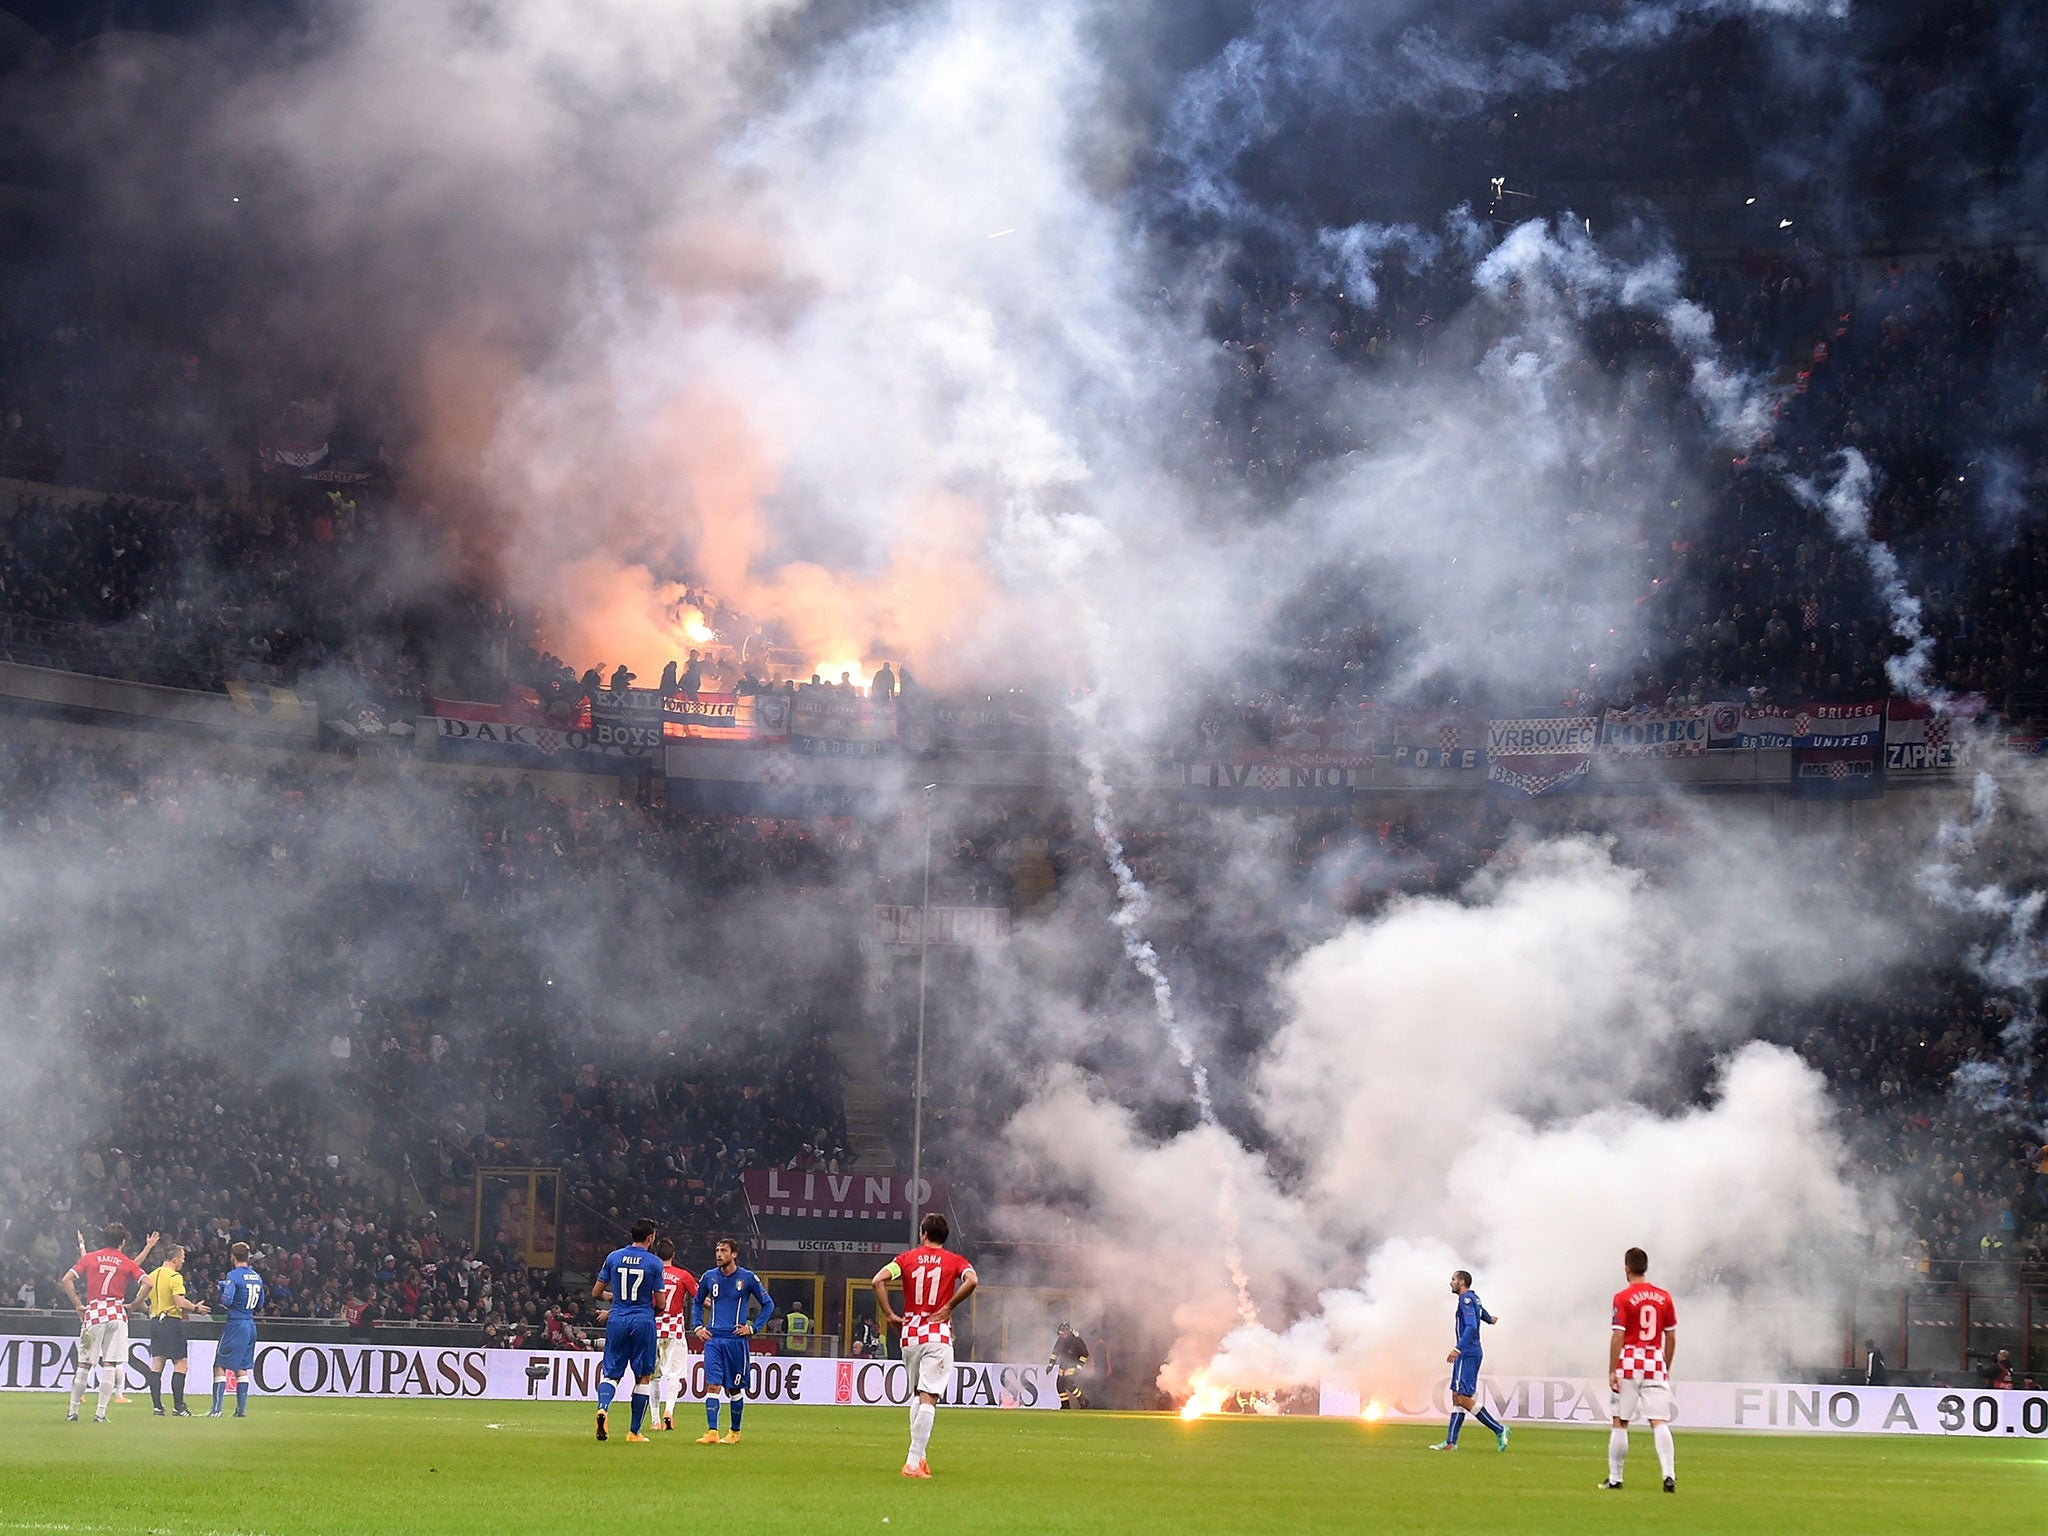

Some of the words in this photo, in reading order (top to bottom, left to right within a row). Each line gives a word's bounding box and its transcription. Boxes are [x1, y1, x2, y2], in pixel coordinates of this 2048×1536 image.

[317, 470, 357, 481] USCITA
[1817, 704, 1875, 719] BRIJEG
[597, 724, 660, 746] BOYS
[803, 738, 881, 754] ZAGREB
[1491, 727, 1593, 747] VRBOVEC
[1813, 735, 1869, 748] UNITED
[768, 1170, 932, 1206] LIVNO
[798, 1240, 836, 1251] USCITA
[841, 1241, 854, 1251] 14
[917, 1254, 942, 1266] SRNA
[99, 1265, 116, 1296] 7
[617, 1267, 645, 1301] 17
[712, 1283, 719, 1298] 8
[911, 1266, 942, 1306] 11
[245, 1283, 262, 1311] 16
[1638, 1304, 1658, 1342] 9
[253, 1345, 488, 1397] COMPASS
[734, 1373, 742, 1386] 8
[856, 1362, 1040, 1408] COPASS
[1734, 1387, 1861, 1429] FINO
[1881, 1392, 1920, 1431] A
